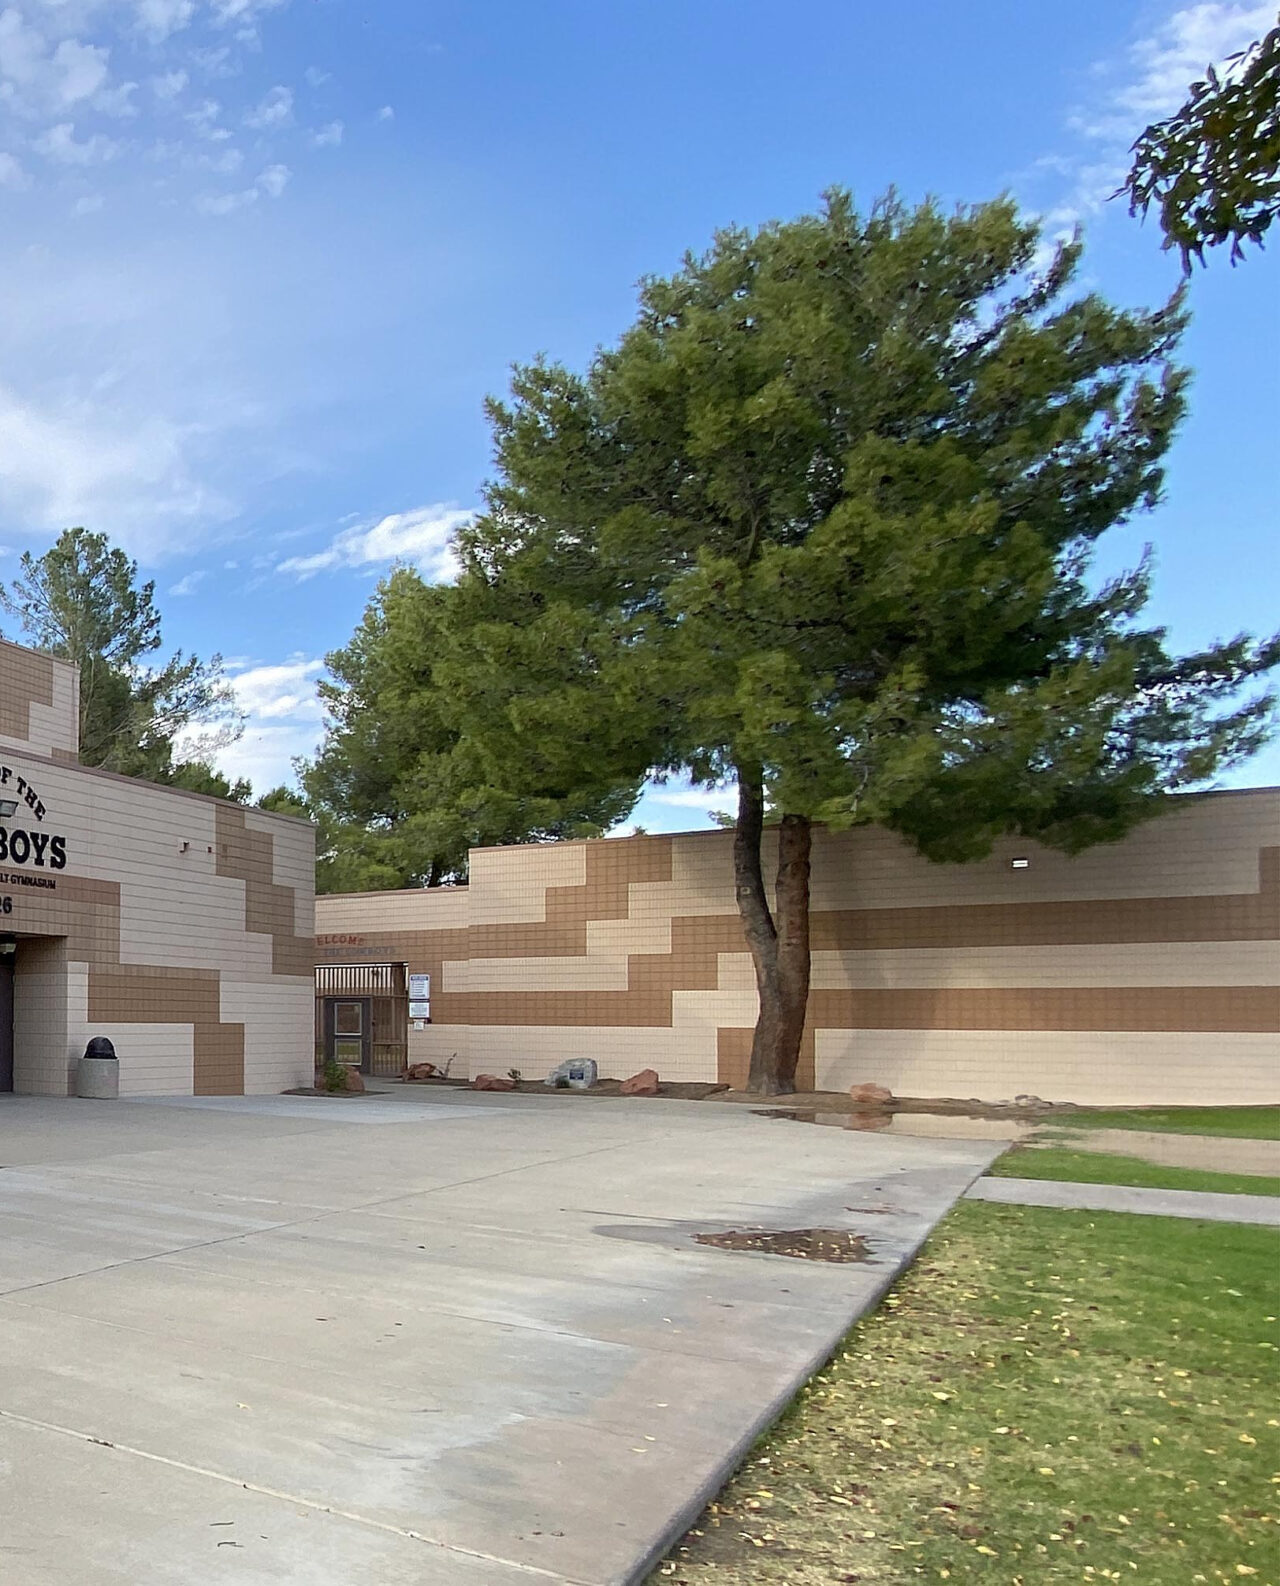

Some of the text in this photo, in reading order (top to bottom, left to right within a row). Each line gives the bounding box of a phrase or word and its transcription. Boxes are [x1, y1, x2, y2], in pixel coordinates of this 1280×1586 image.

[17, 776, 47, 821] THE
[10, 874, 56, 890] GYMNASIUM
[316, 935, 365, 946] ELCOME
